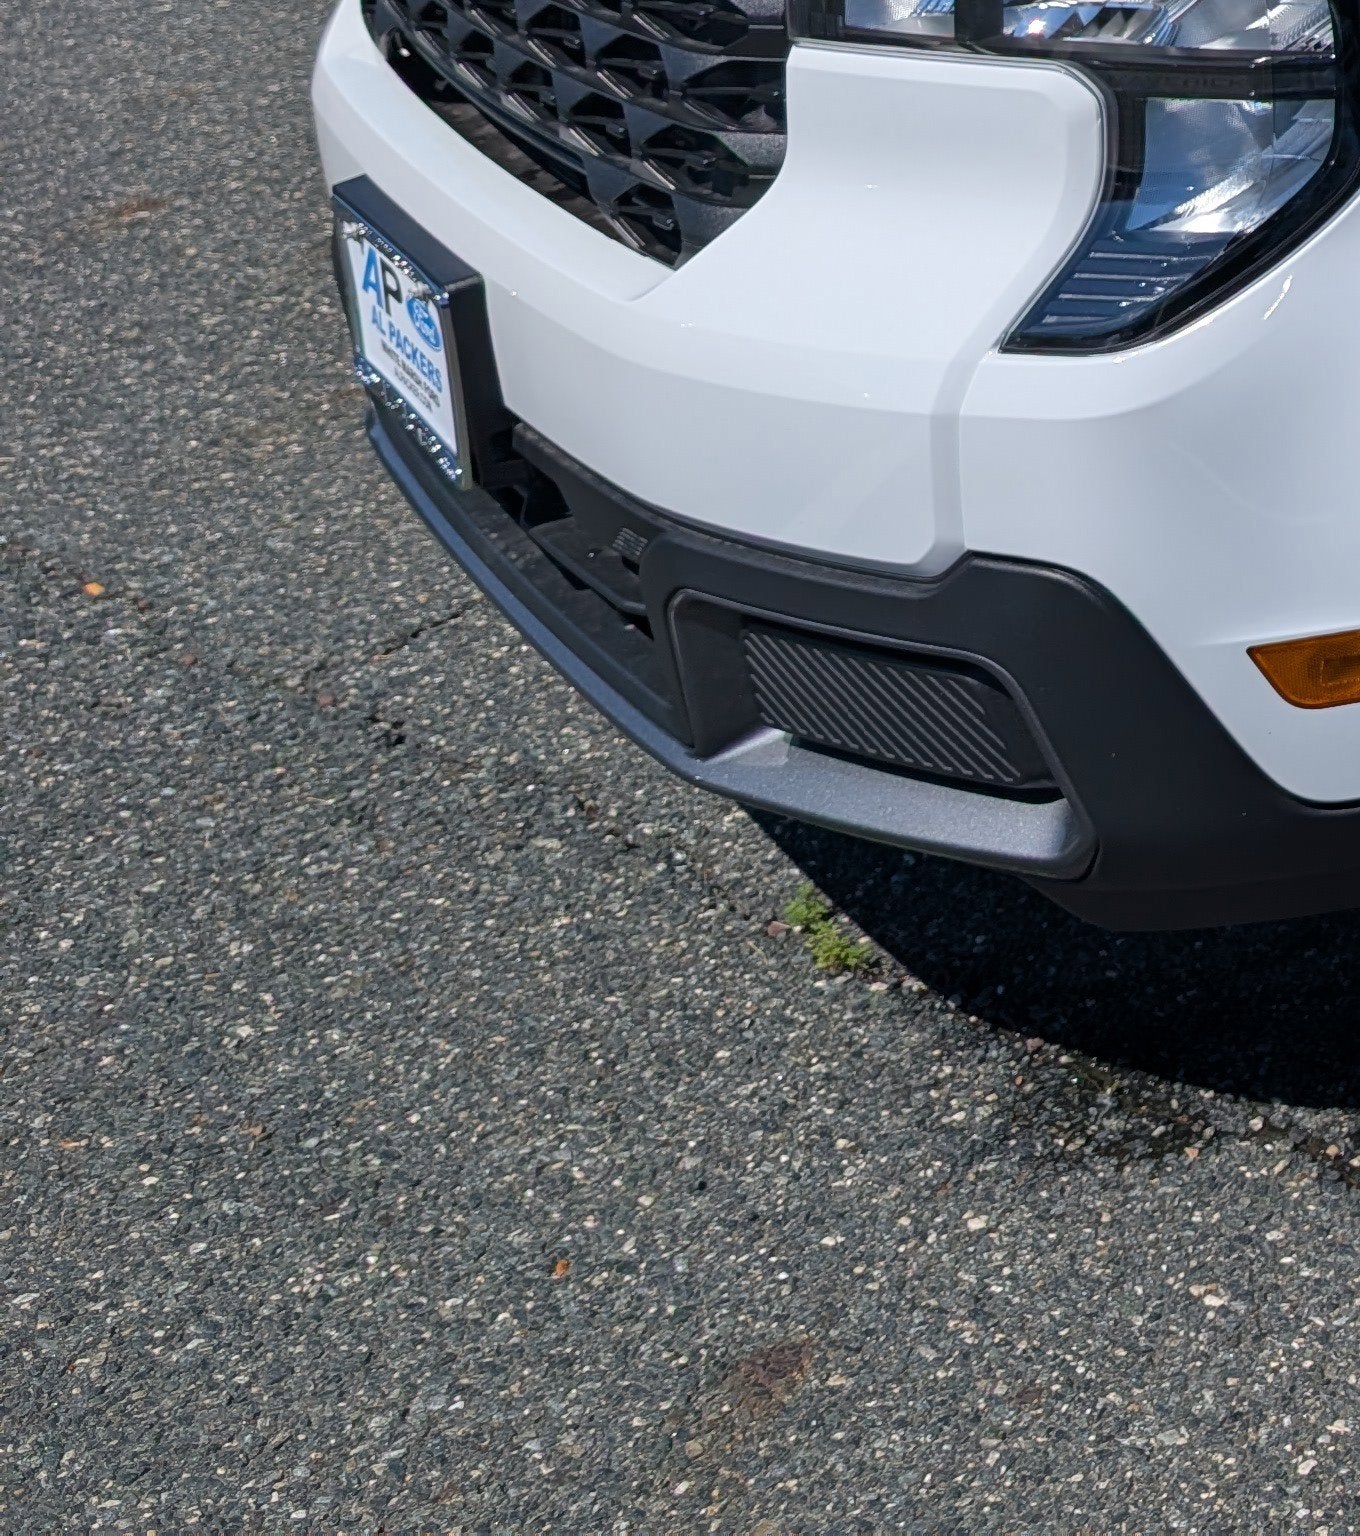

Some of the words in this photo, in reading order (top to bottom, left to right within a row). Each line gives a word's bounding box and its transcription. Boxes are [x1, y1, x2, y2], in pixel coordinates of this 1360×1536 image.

[362, 247, 403, 317] AP
[371, 304, 386, 336] AL
[388, 320, 443, 394] PACKERS
